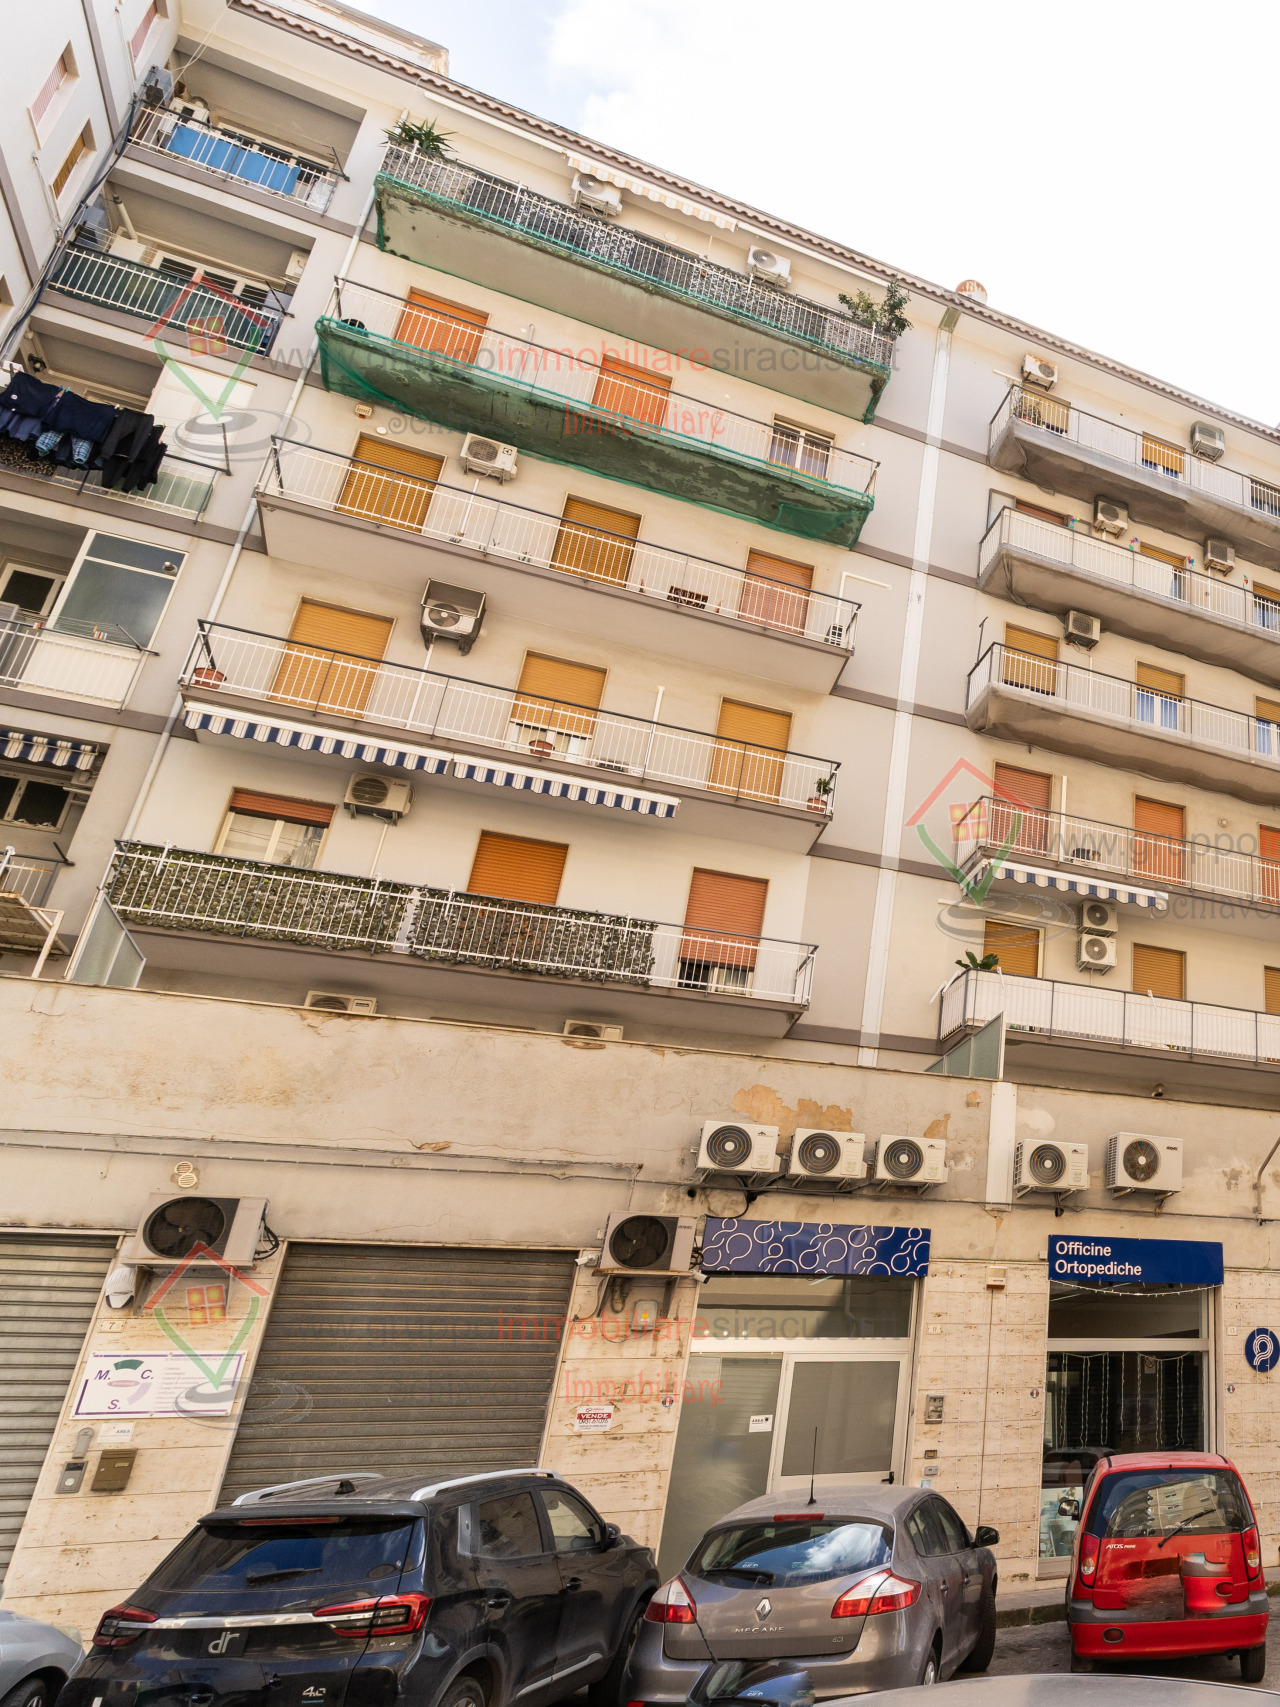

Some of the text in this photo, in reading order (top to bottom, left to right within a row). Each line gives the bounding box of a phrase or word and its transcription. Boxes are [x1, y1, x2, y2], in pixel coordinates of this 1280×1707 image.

[1055, 1241, 1112, 1257] Officine
[1055, 1259, 1142, 1277] Ortopediche
[108, 1321, 116, 1330] 7
[208, 1631, 240, 1655] dr
